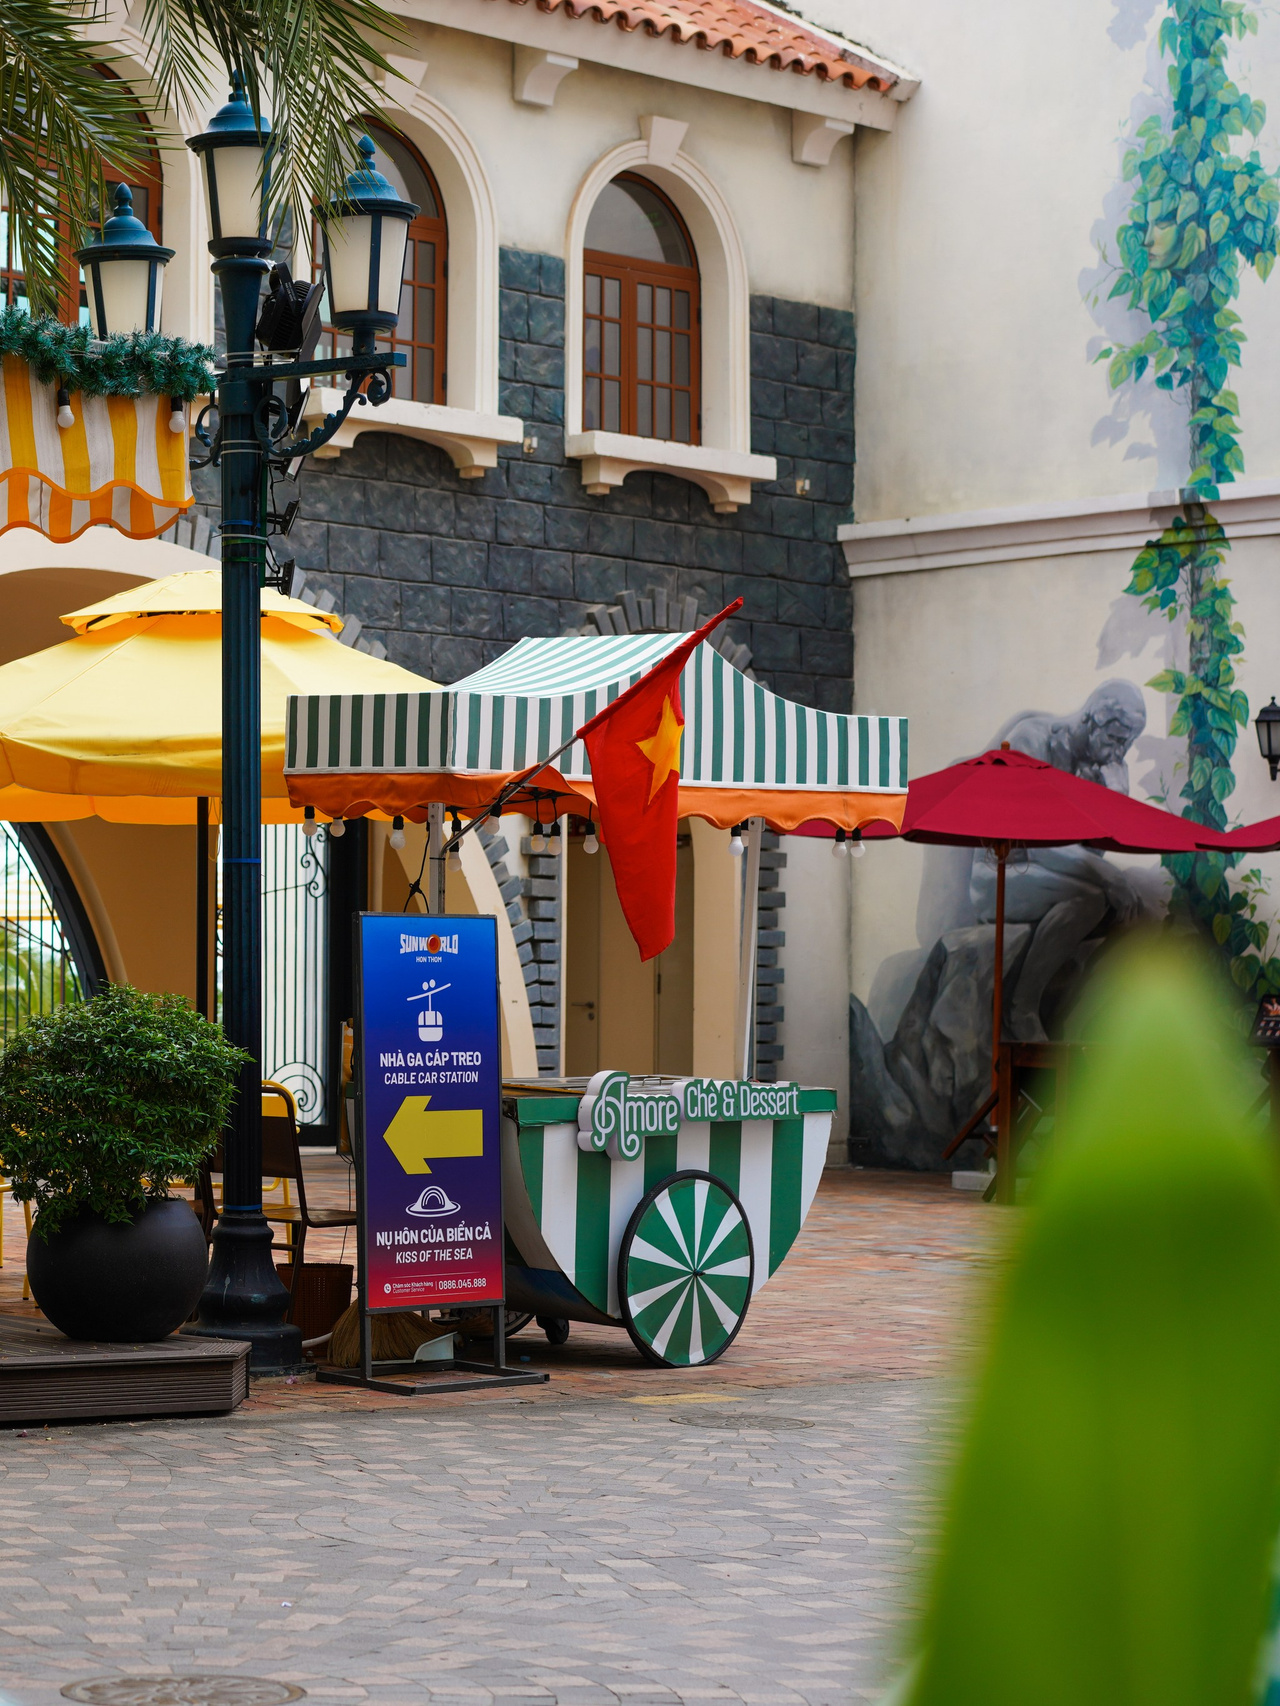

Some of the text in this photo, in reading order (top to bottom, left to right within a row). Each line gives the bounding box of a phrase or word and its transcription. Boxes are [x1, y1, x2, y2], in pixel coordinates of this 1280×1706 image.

[380, 1049, 482, 1068] NHÀ GA CÁP TREO
[384, 1071, 479, 1085] CABLE CAR STATION
[593, 1075, 799, 1158] Amore Chè & Dessert
[376, 1220, 492, 1250] NỤ HÔN CỦA BIỂN CẢ
[395, 1247, 473, 1264] KISS OF THE SEA
[438, 1277, 487, 1290] 0886.045.888
